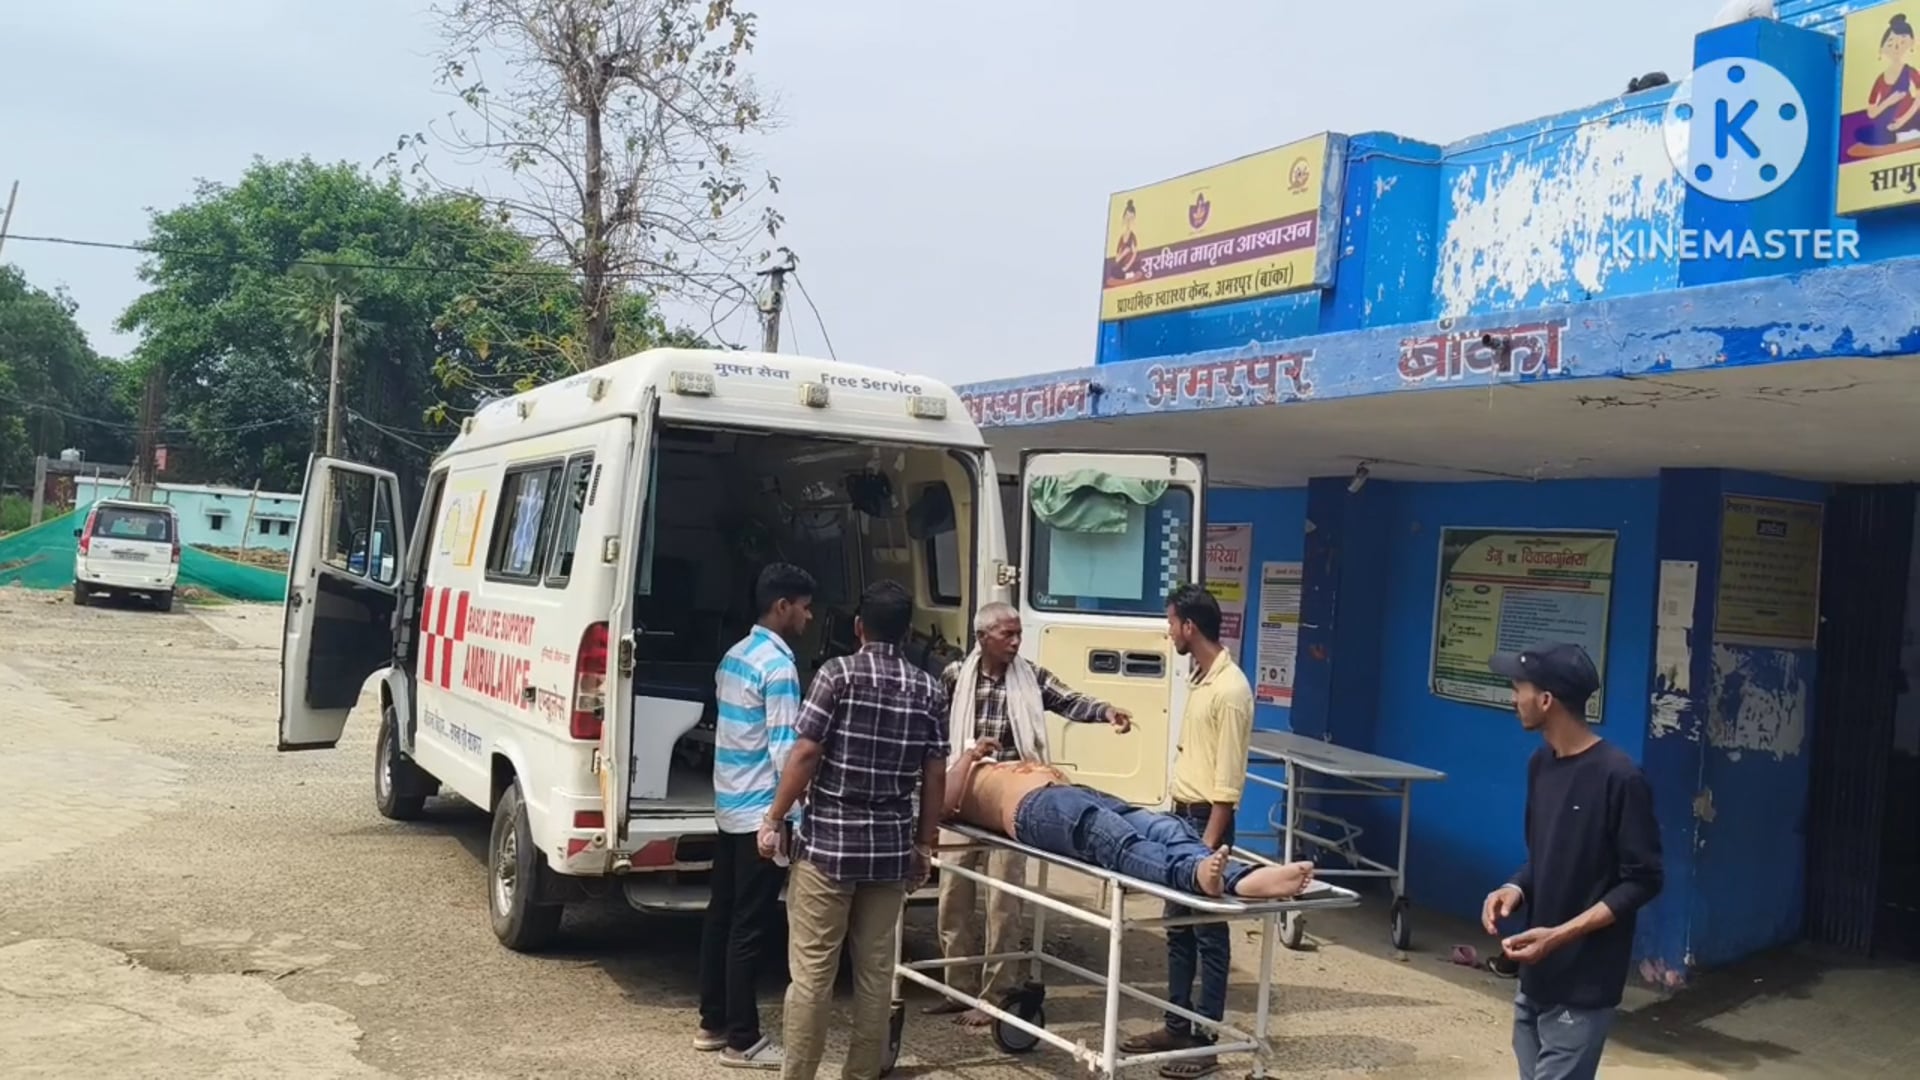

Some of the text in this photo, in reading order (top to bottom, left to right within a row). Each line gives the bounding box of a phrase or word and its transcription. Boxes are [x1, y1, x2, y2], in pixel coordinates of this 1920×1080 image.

[1141, 220, 1312, 279] सुरक्षित मातृत्व आश्वासन
[1117, 290, 1154, 313] प्राथमिक
[1255, 263, 1294, 291] (बांका)
[757, 365, 791, 380] सेवा
[820, 372, 922, 396] Free Service
[467, 606, 535, 646] BASIC LIFE SUPPORT
[462, 644, 531, 710] AMBULANCE
